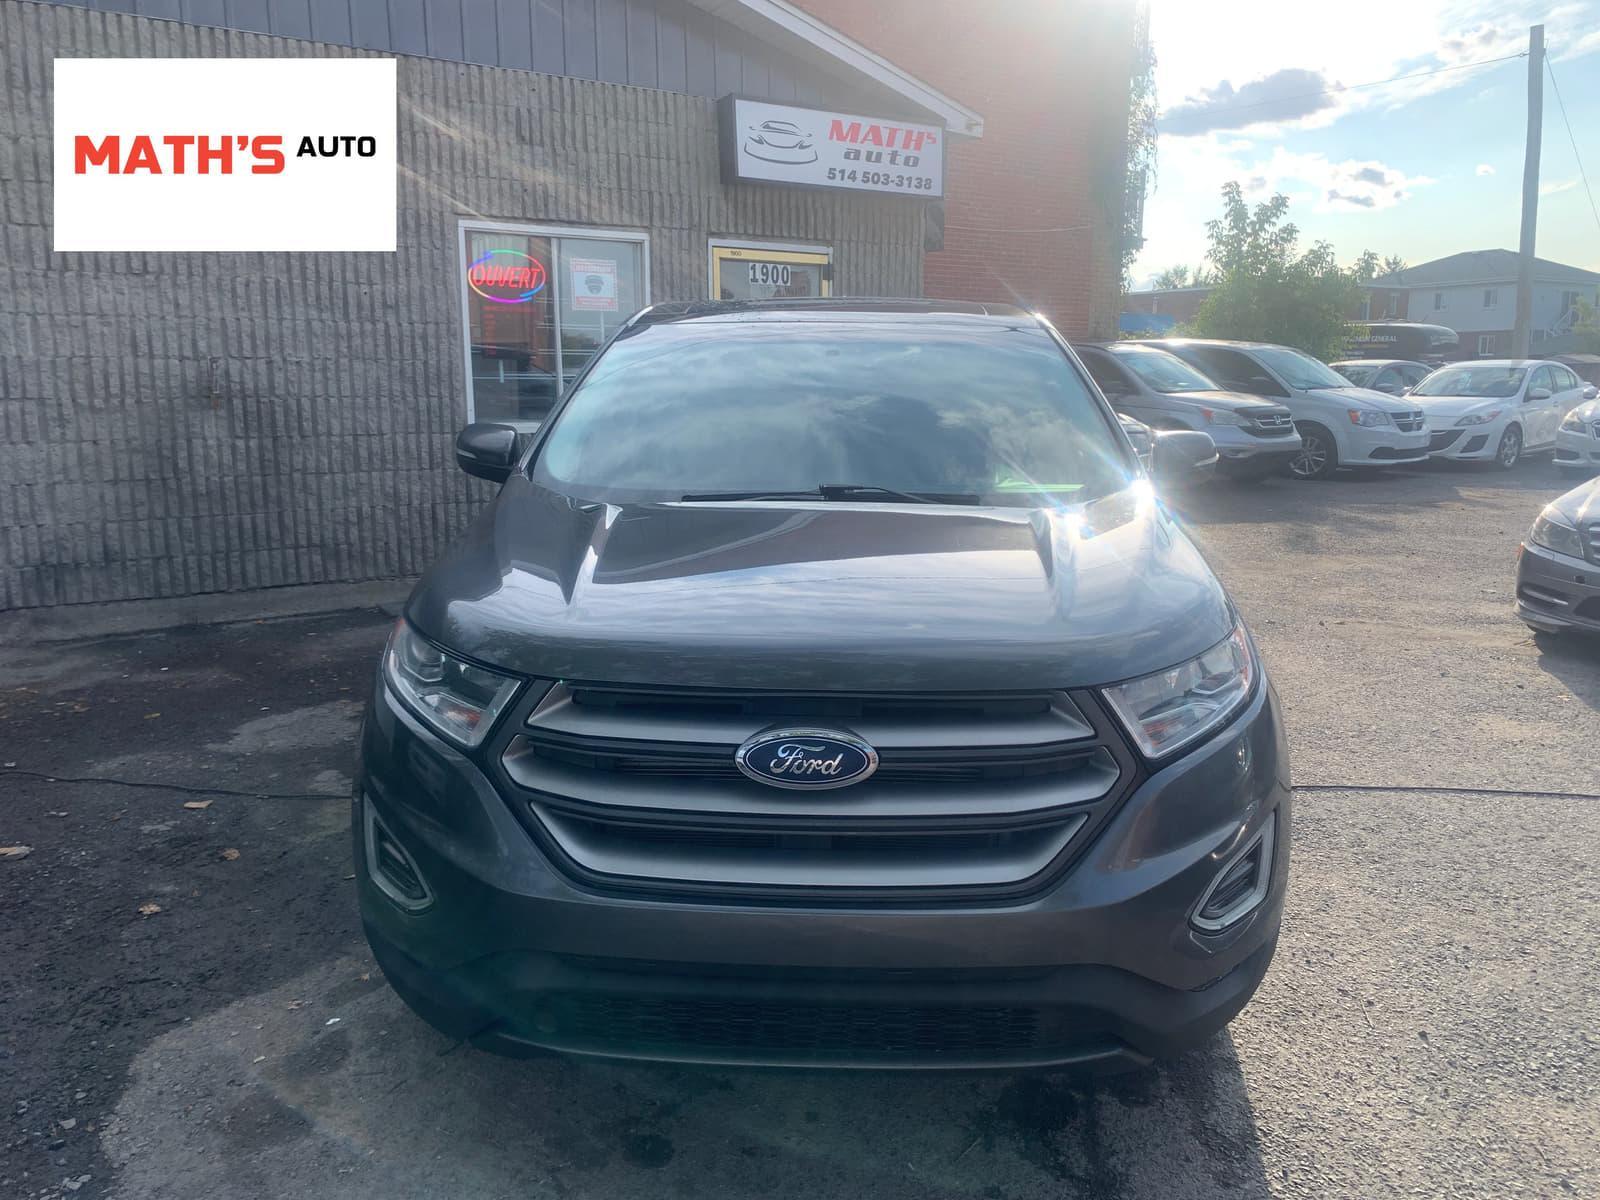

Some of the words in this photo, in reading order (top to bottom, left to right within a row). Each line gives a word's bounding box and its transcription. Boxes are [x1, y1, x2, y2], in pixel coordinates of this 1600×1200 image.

[843, 147, 921, 168] auto
[827, 167, 858, 183] 514
[861, 171, 933, 190] 503-3138
[472, 263, 541, 289] OUVERT
[749, 263, 790, 285] 1900
[769, 743, 844, 775] Ford
